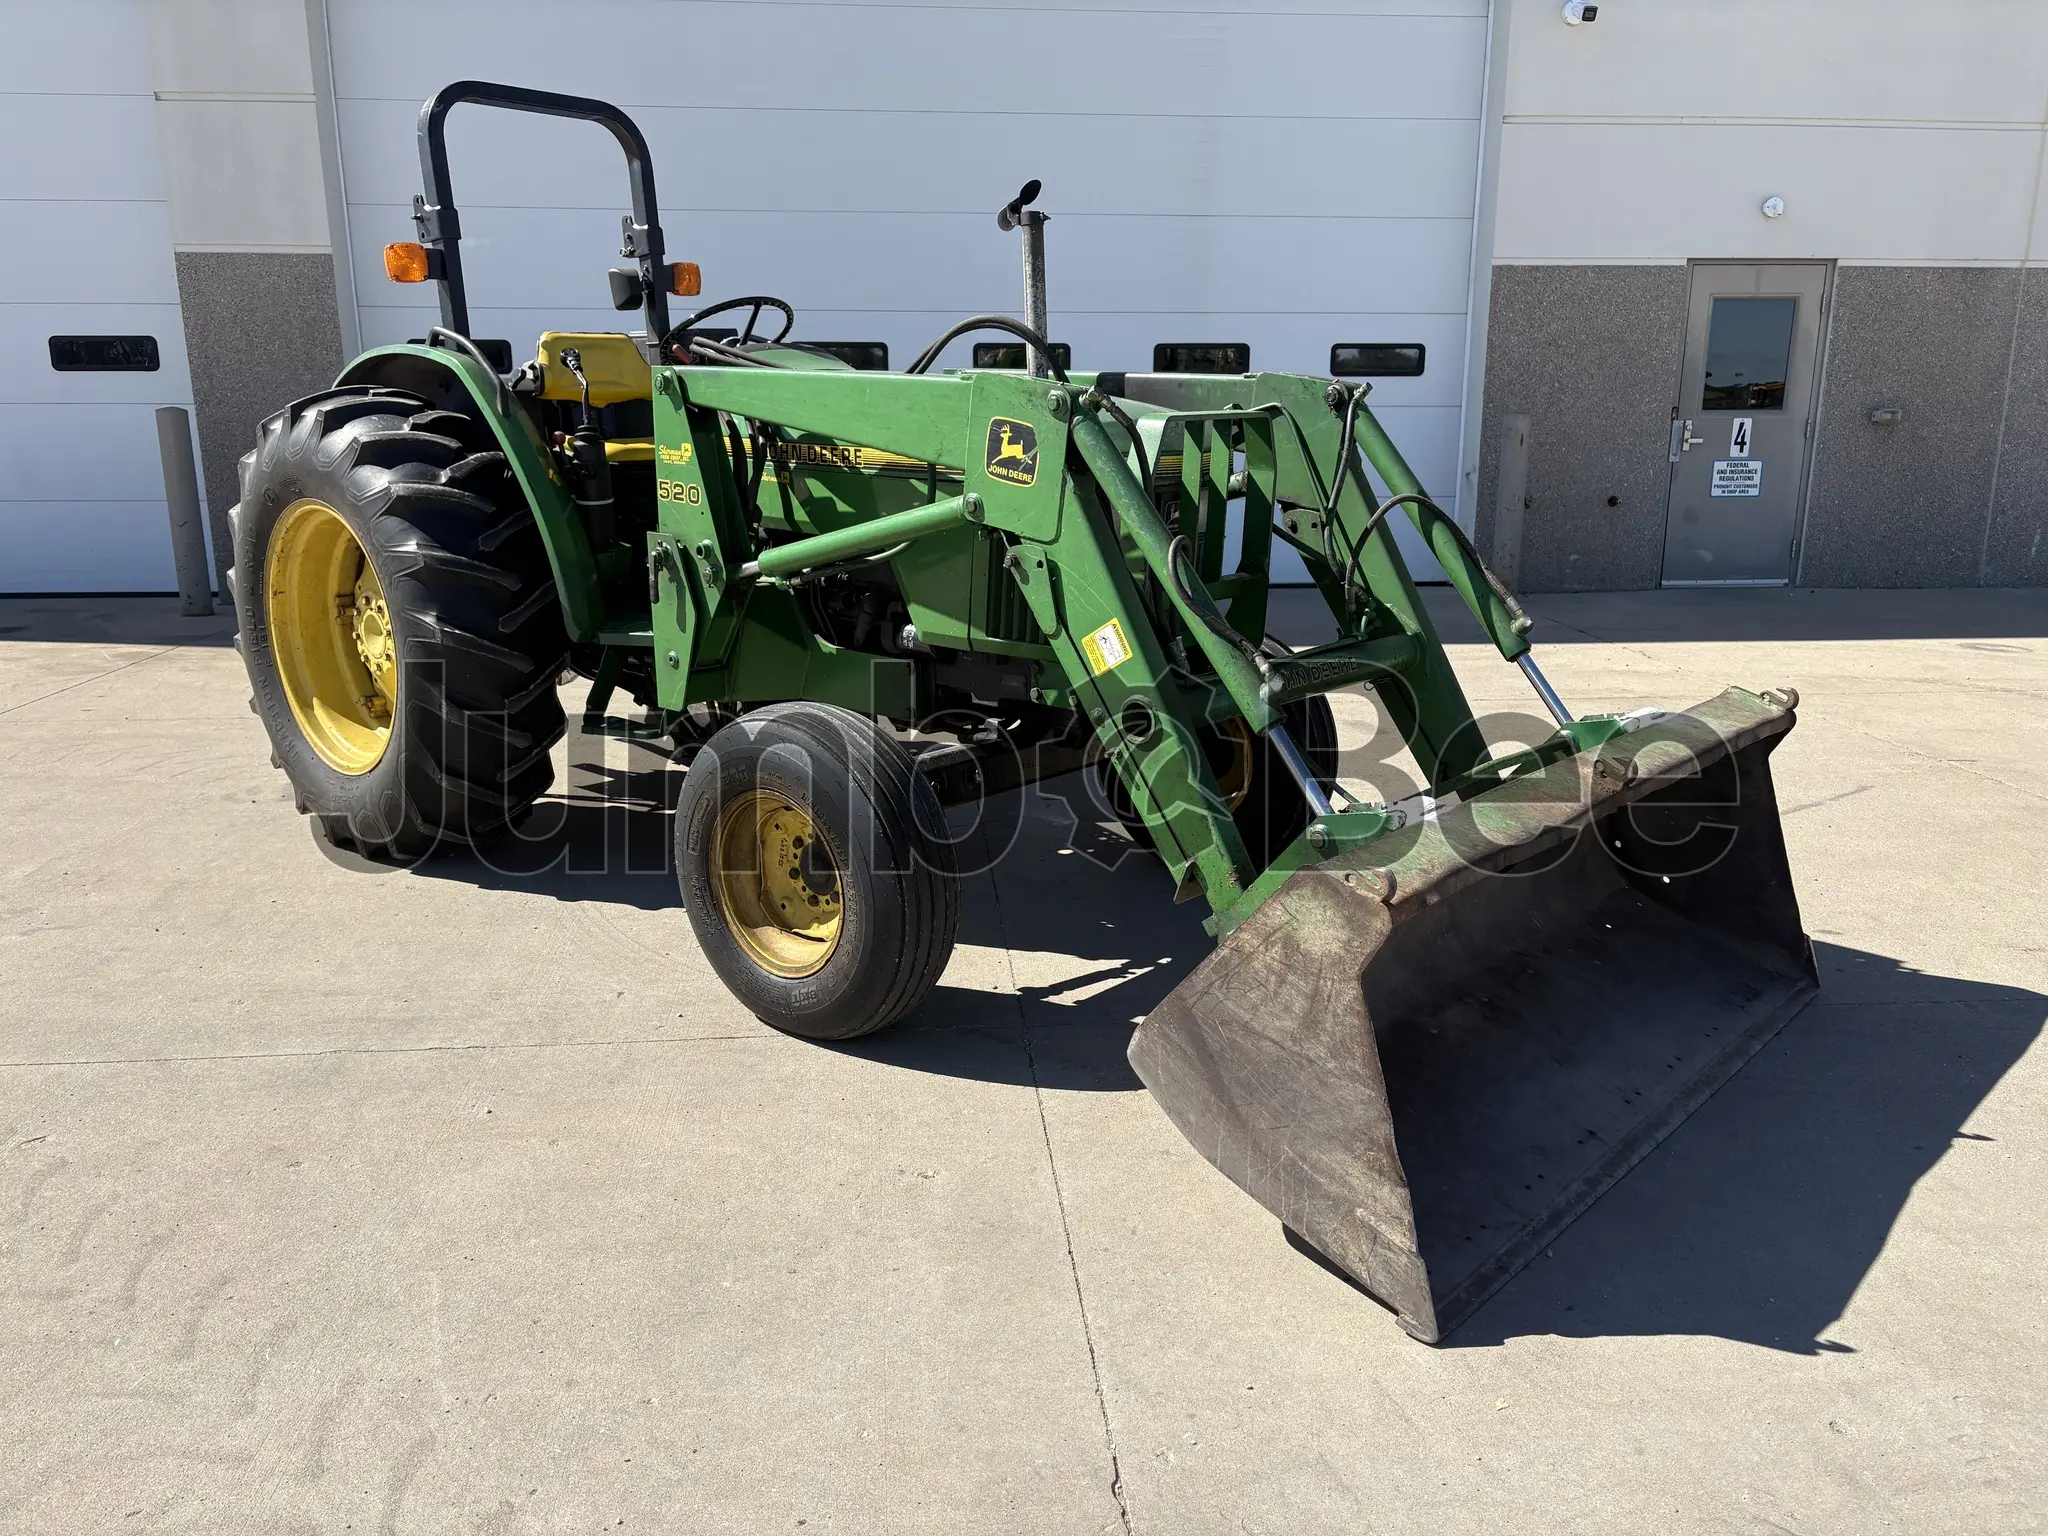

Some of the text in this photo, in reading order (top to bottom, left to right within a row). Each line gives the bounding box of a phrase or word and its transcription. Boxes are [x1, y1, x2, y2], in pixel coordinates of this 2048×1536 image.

[1734, 421, 1747, 453] 4
[766, 441, 863, 467] OHN DEERE
[988, 464, 1033, 483] JOHN DEERE
[657, 478, 702, 506] 520
[1310, 656, 1359, 683] DEERE
